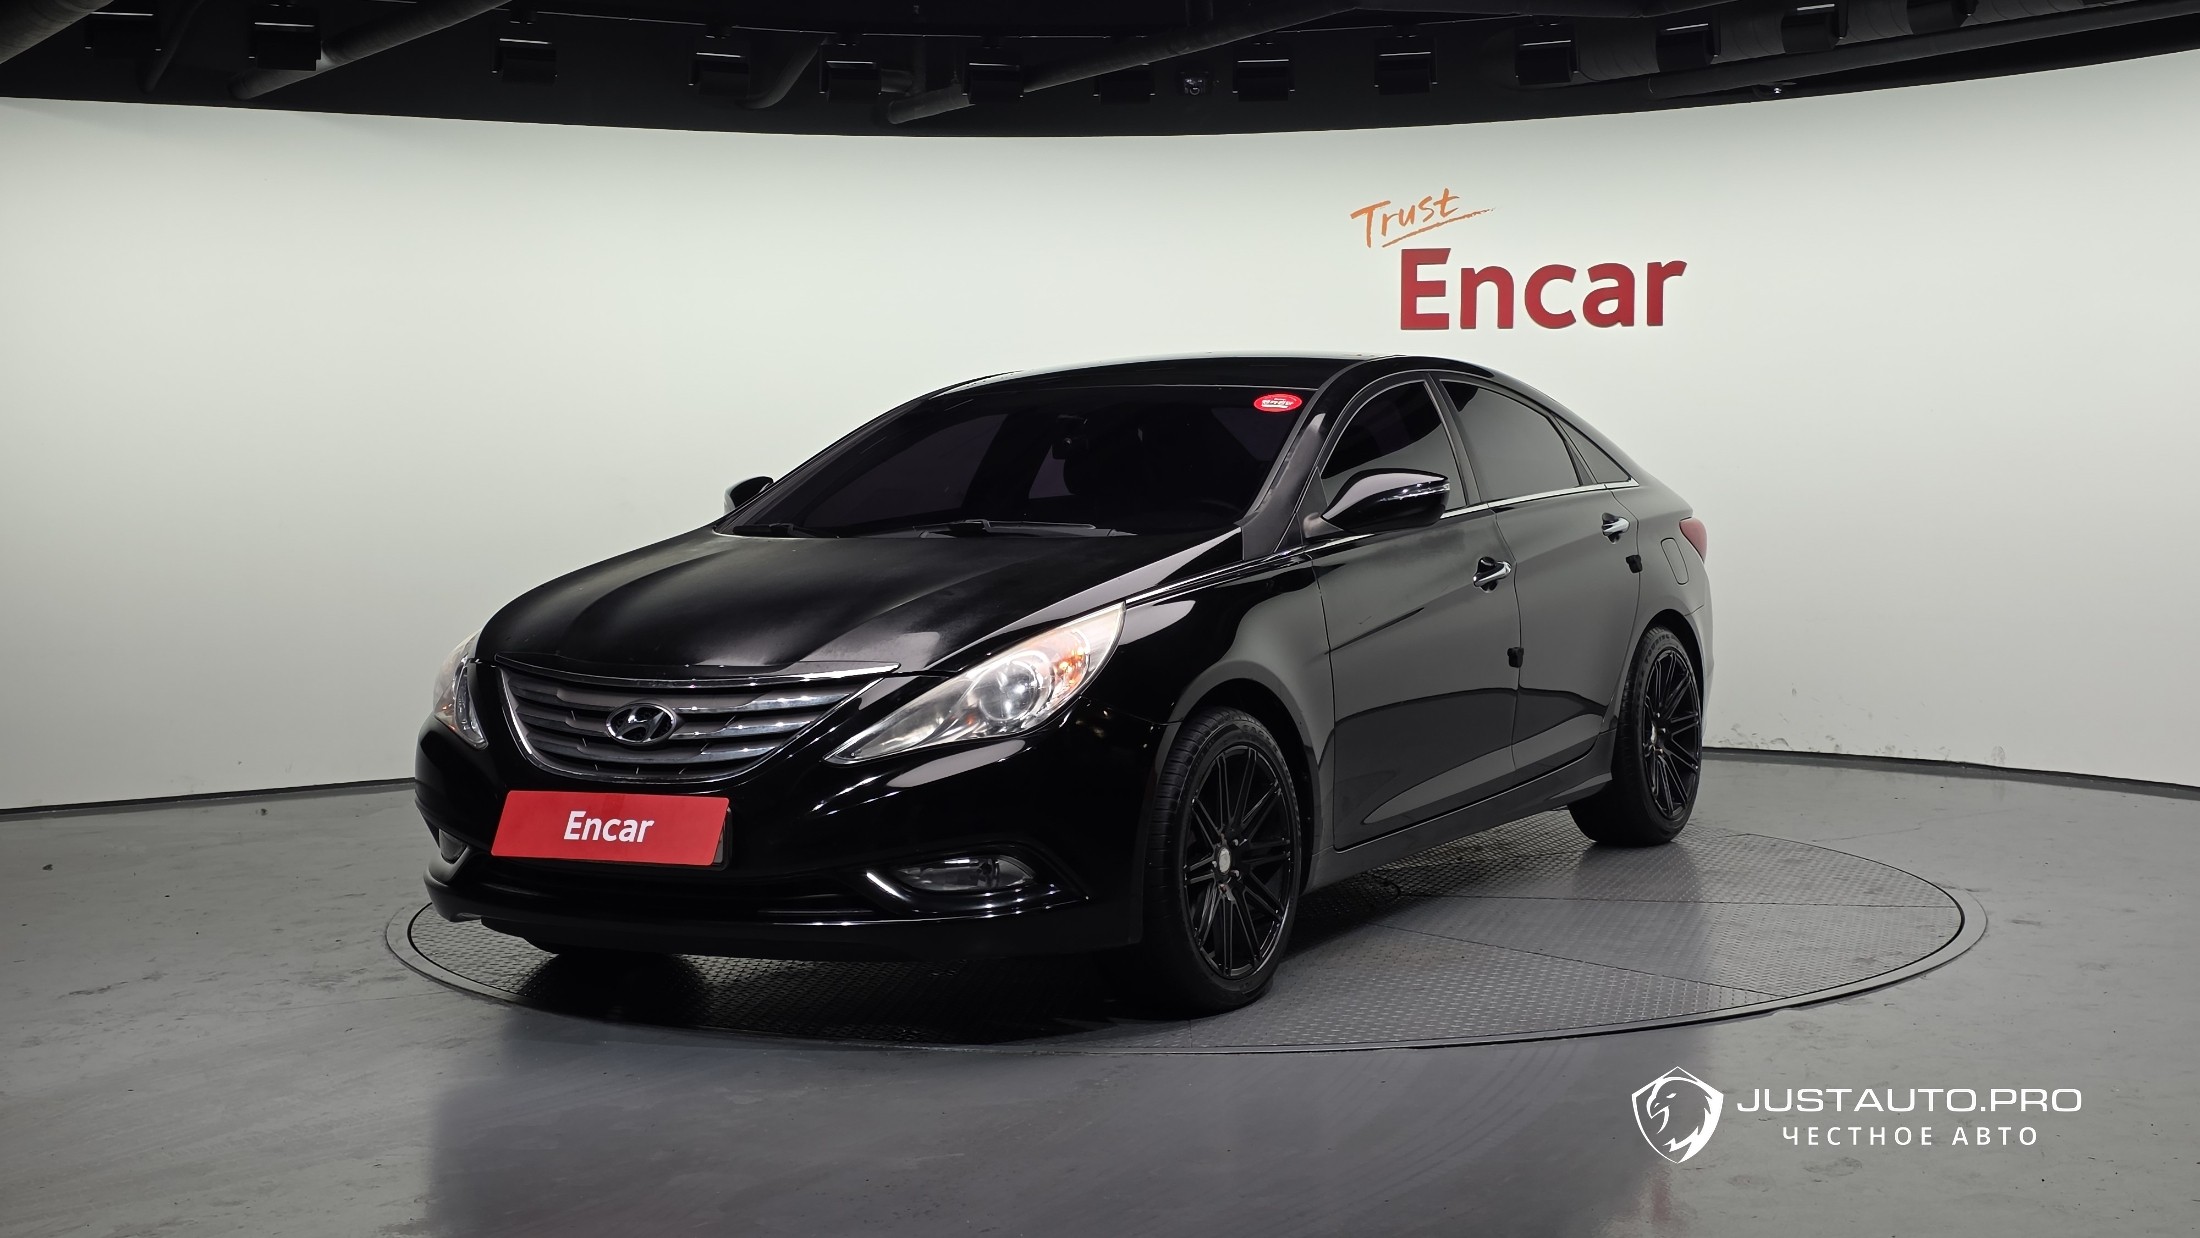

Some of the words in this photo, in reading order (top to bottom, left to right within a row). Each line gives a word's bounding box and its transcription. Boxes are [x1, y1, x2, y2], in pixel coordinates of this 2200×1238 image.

[1350, 188, 1460, 248] Trust
[1400, 248, 1687, 330] Encar
[563, 811, 655, 843] Encar
